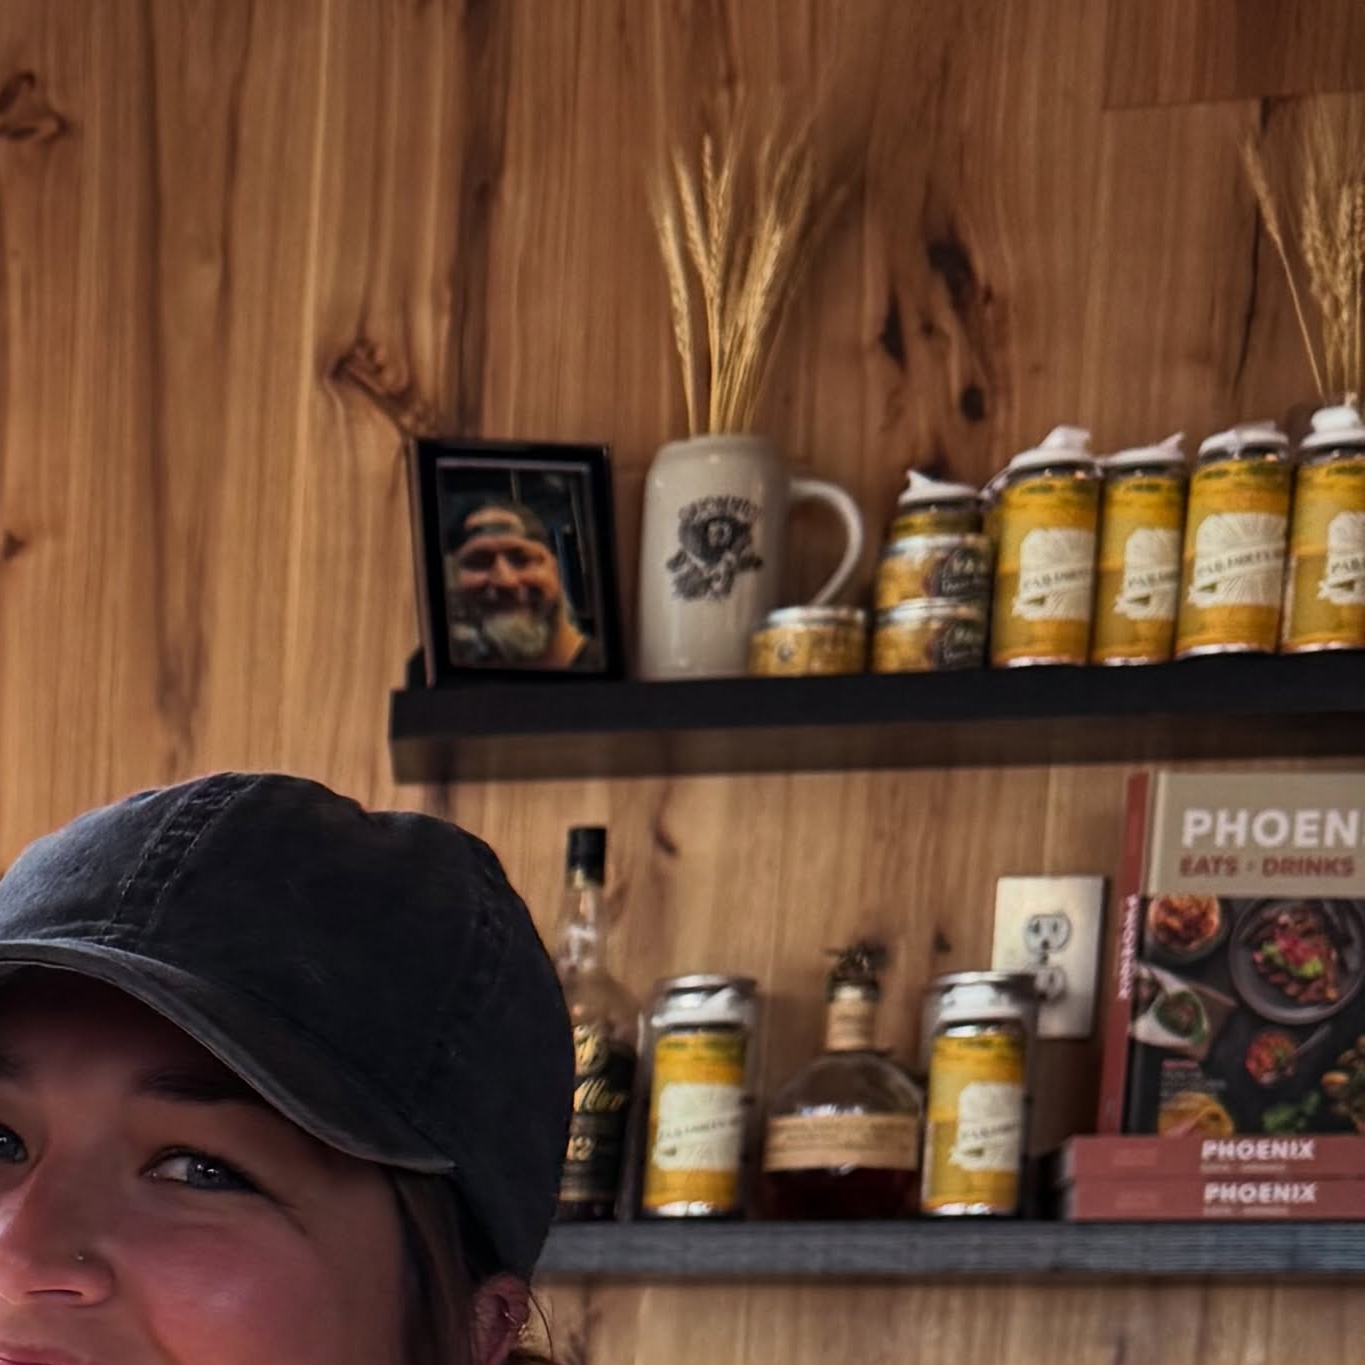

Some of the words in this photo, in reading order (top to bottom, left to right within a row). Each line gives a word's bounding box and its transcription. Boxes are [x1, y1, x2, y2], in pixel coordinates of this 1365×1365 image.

[1181, 808, 1365, 849] PHOEN
[1179, 855, 1238, 878] EATS
[1261, 855, 1356, 878] DRINKS
[1200, 1138, 1316, 1161] PHOENIX
[1203, 1181, 1318, 1205] PHOENIX
